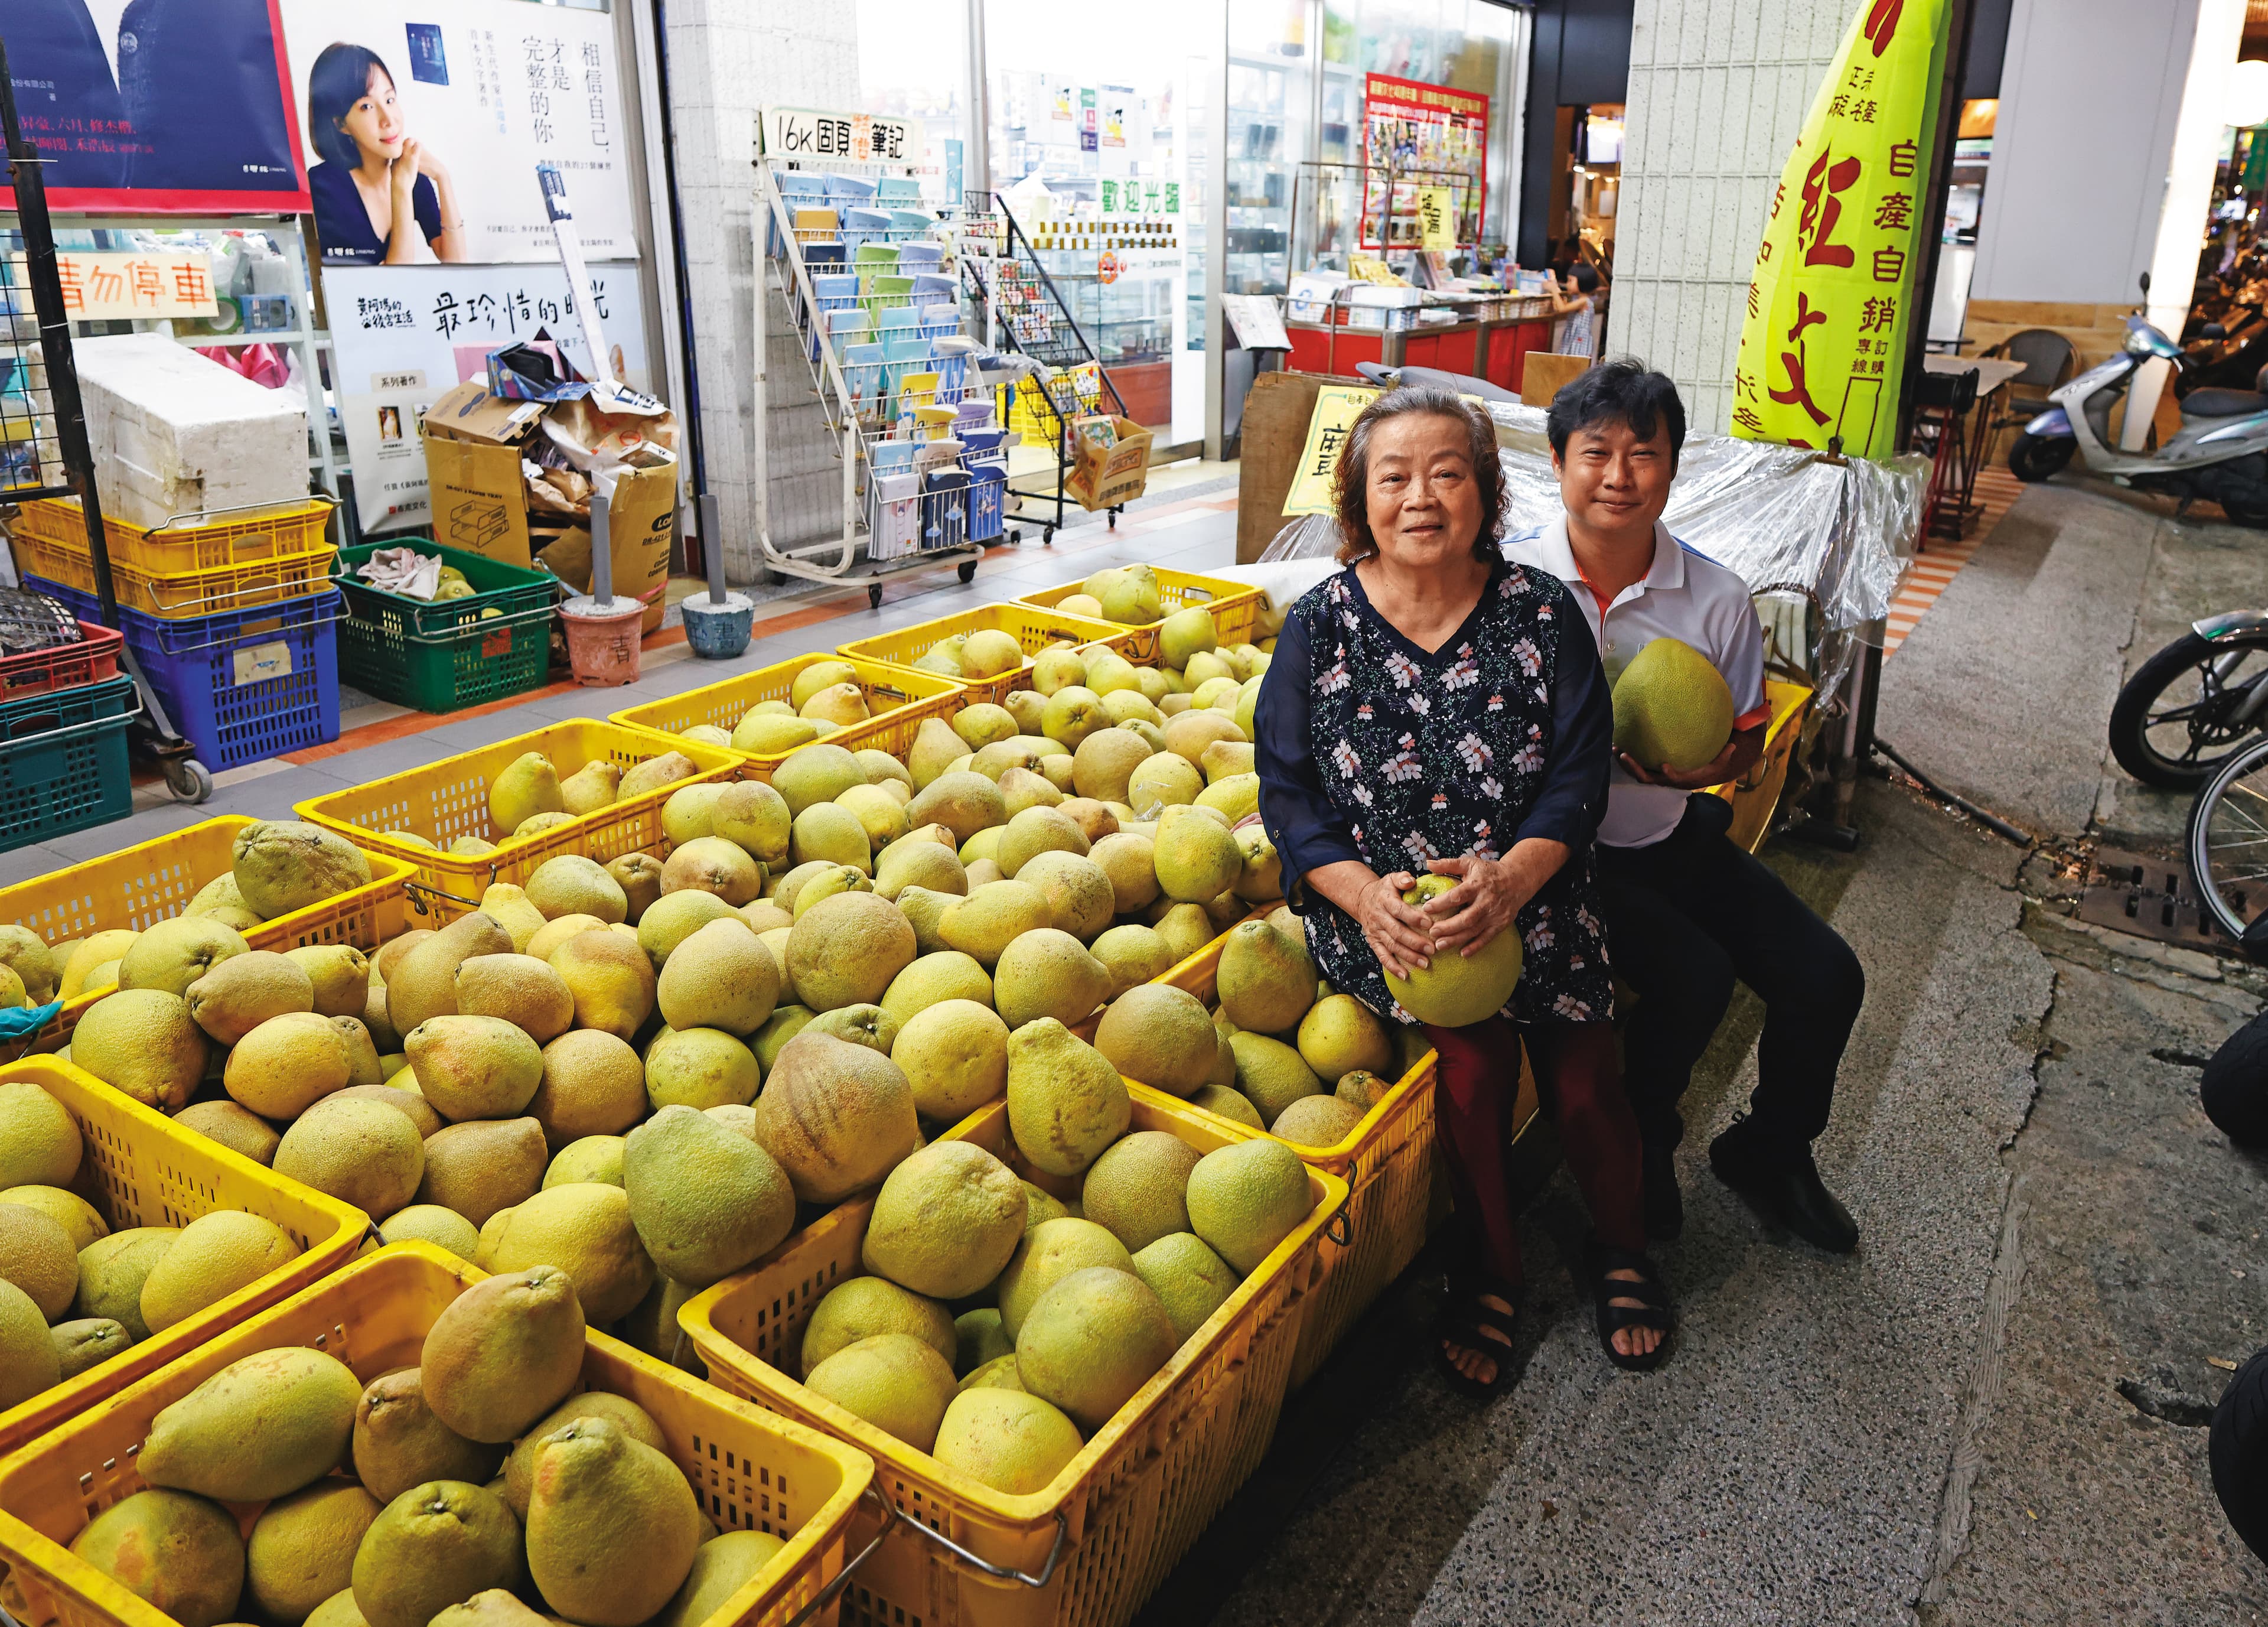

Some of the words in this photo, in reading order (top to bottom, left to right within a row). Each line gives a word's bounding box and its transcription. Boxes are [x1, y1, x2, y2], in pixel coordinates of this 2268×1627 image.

[523, 35, 553, 143] 完整的你
[546, 38, 571, 90] 才是
[1102, 180, 1179, 213] 歡迎光臨
[1858, 139, 1918, 333] 自產自銷
[381, 375, 417, 389] 系列著作
